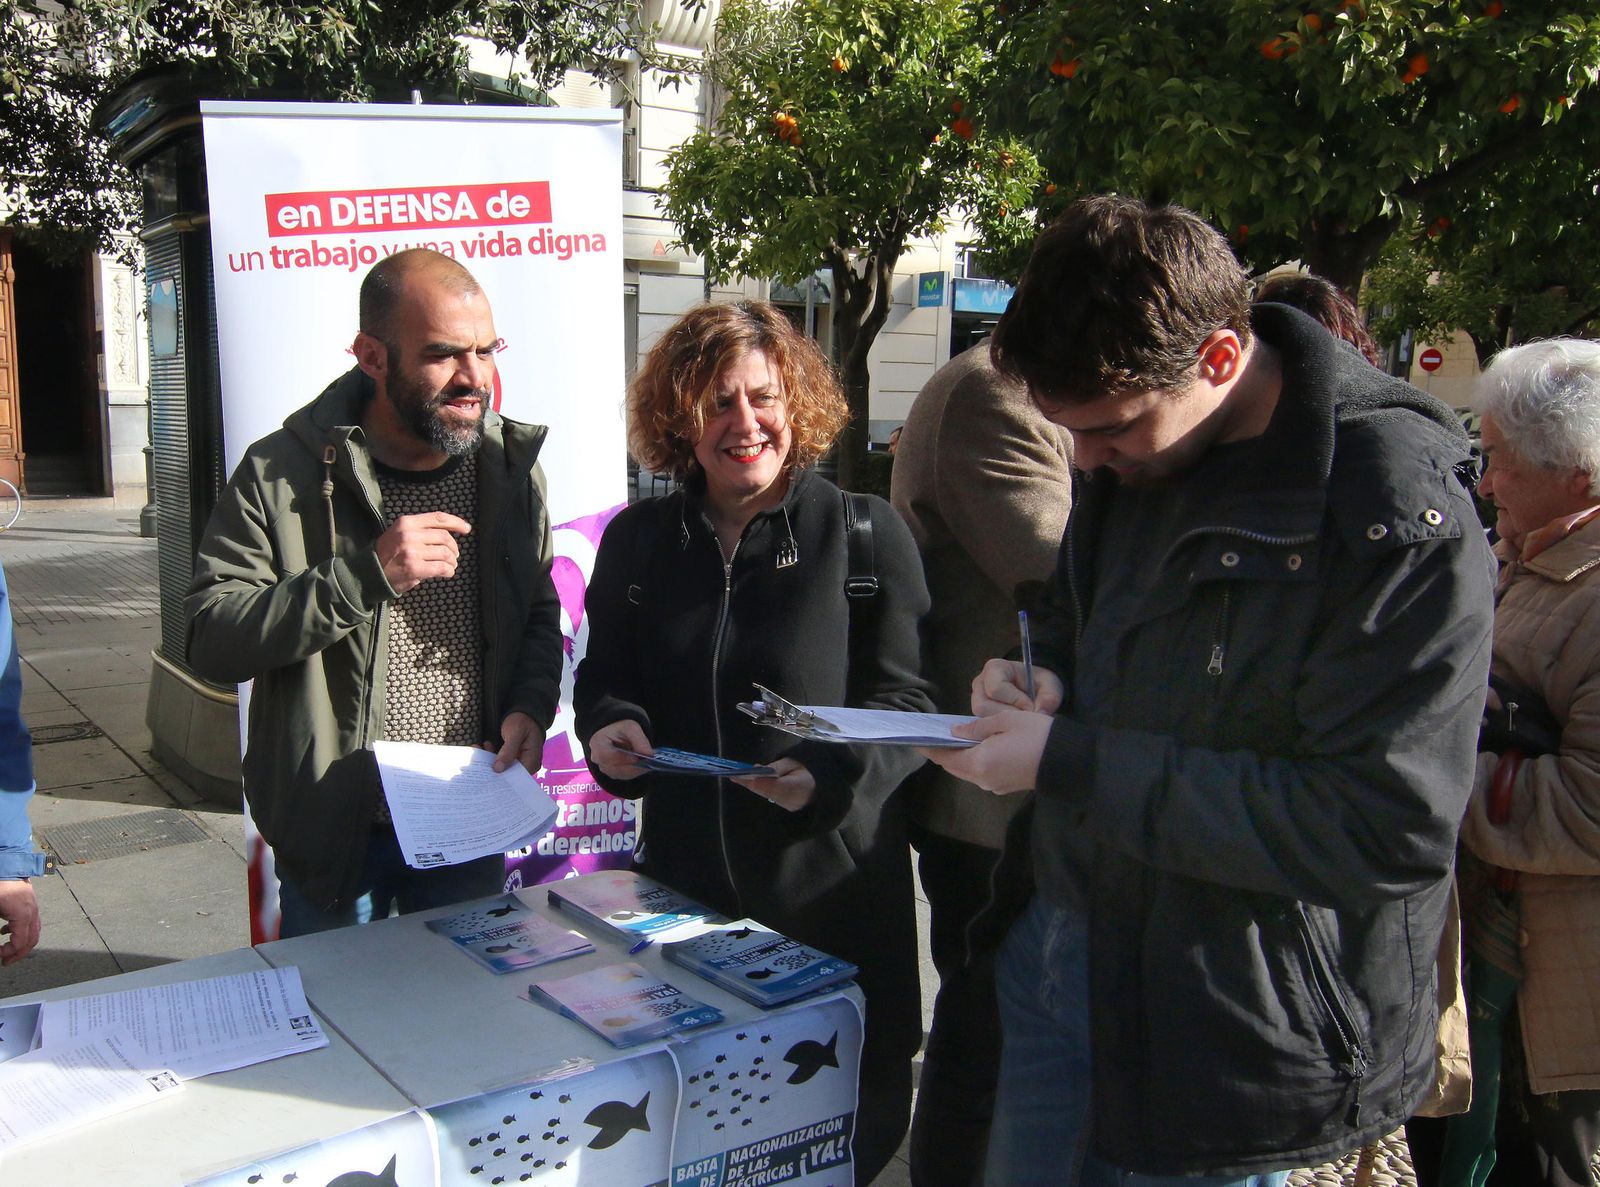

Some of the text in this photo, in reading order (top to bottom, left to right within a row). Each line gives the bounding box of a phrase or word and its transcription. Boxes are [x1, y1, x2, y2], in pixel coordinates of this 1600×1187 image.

[277, 189, 531, 229] en DEFENSA de
[228, 248, 264, 272] un
[270, 237, 377, 272] trabajo
[461, 230, 521, 259] vida
[528, 227, 607, 264] digna
[555, 798, 636, 828] tamos
[537, 828, 635, 856] derechos
[729, 1117, 844, 1165] NACIONALIZACIÓN
[799, 1135, 846, 1177] ¡YA!
[676, 1157, 719, 1182] BASTA
[699, 1174, 716, 1187] DE
[727, 1156, 771, 1180] DE LAS
